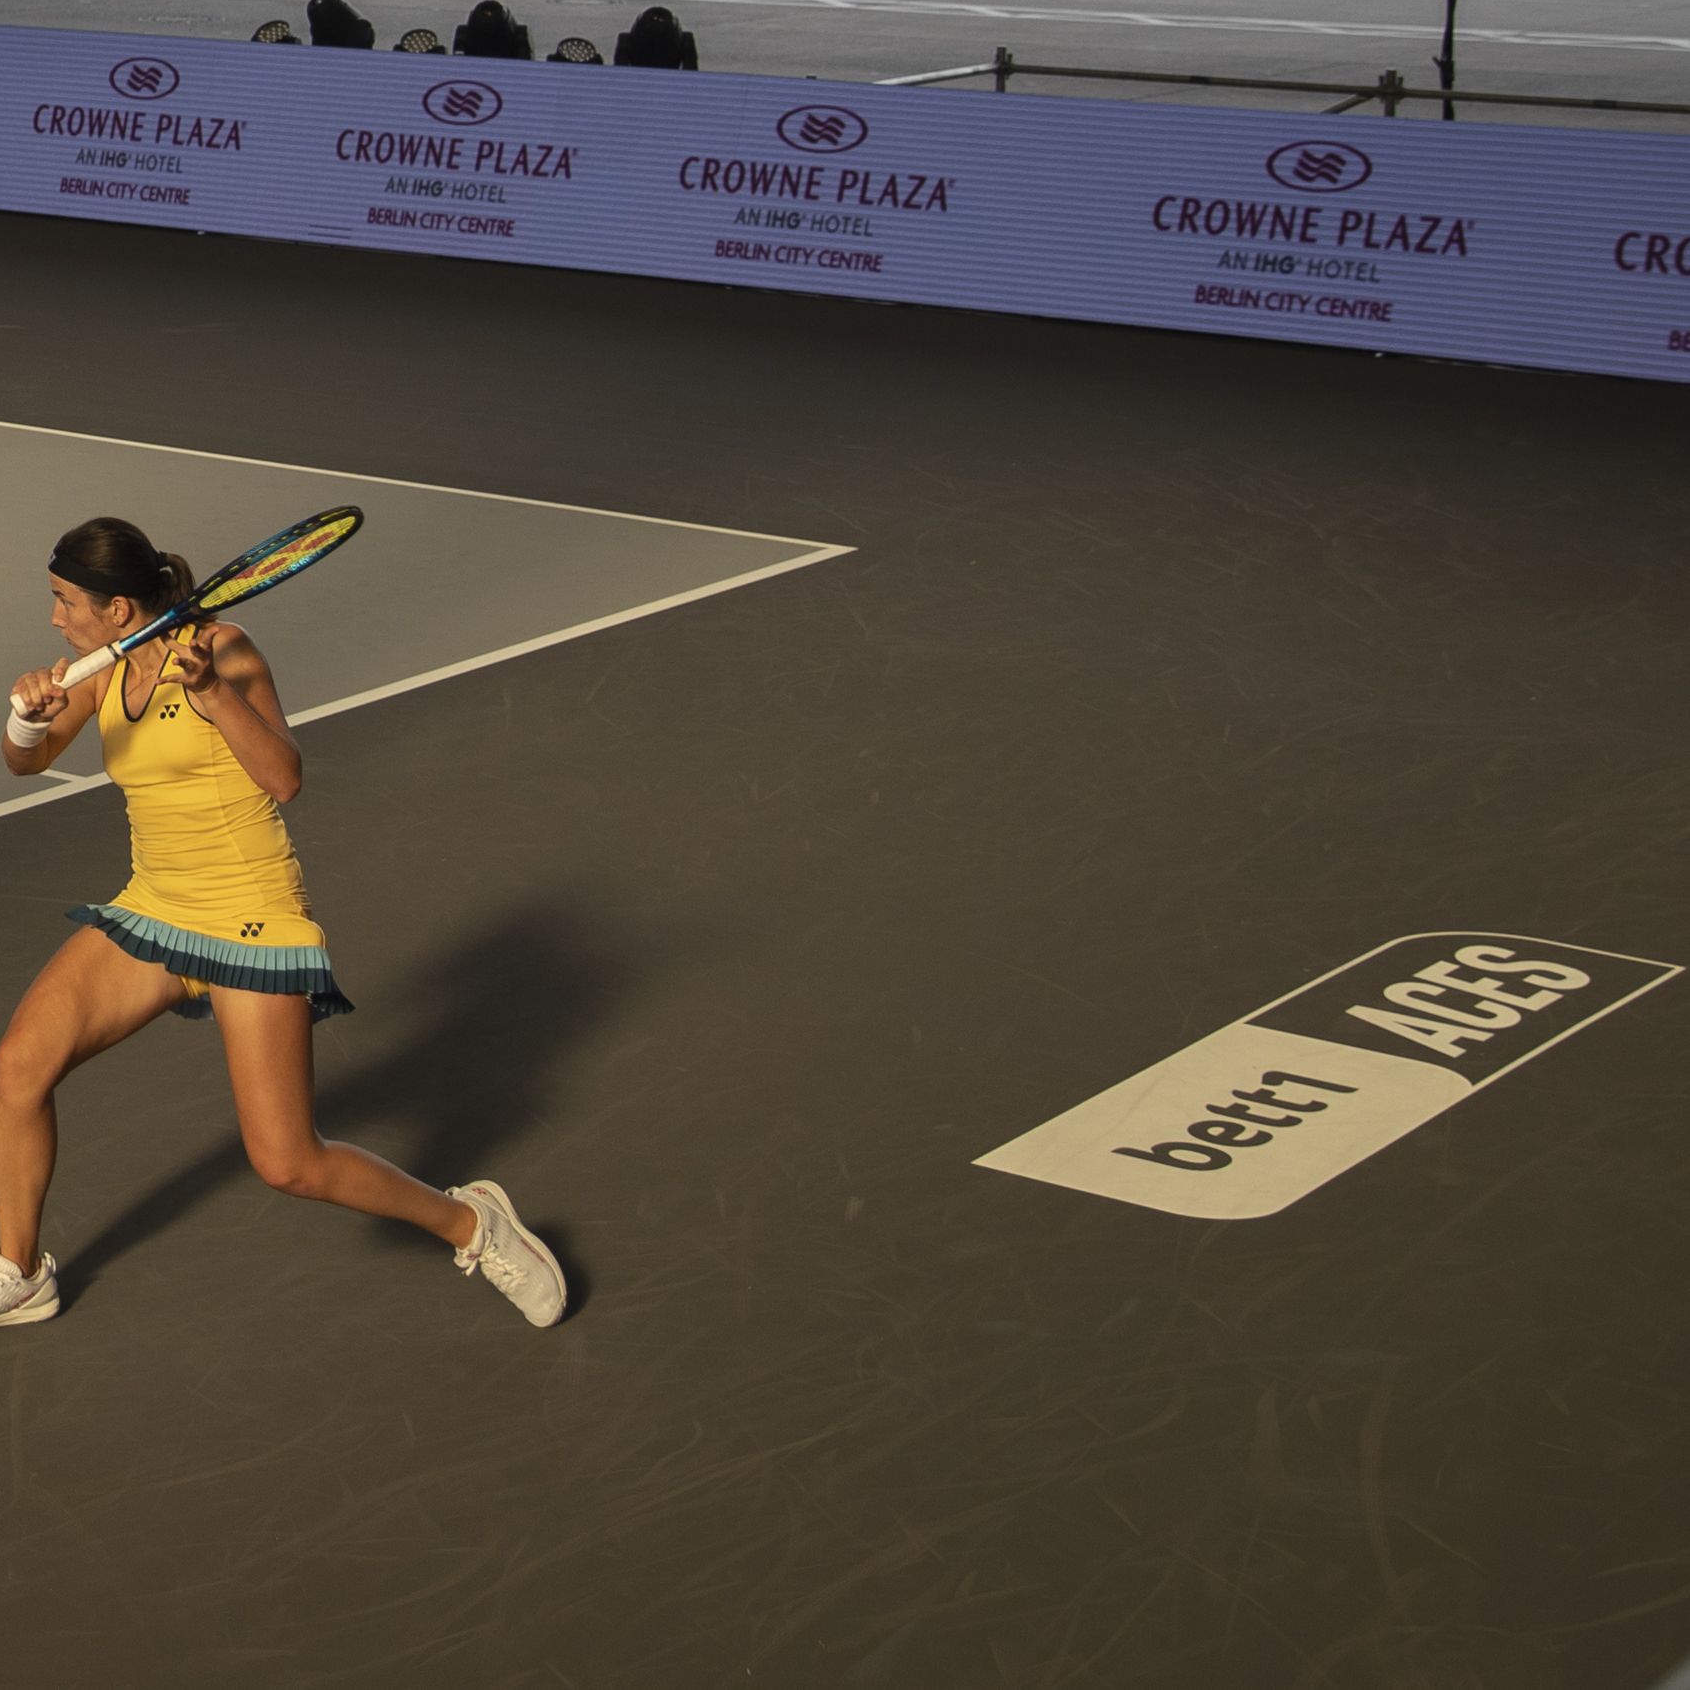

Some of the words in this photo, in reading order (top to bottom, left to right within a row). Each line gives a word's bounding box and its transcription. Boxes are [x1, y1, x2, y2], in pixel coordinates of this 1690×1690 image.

[32, 103, 147, 142] CROWNE
[155, 113, 241, 151] PLAZA
[75, 148, 97, 166] AN
[99, 151, 129, 169] IHG
[133, 154, 184, 175] HOTEL
[336, 128, 465, 171] CROWNE
[474, 139, 572, 180] PLAZA
[59, 177, 104, 197] BERLIN
[106, 181, 138, 200] CITY
[139, 184, 192, 206] CENTRE
[383, 176, 408, 196] AN
[411, 178, 444, 198] IHG
[450, 183, 508, 205] HOTEL
[679, 156, 826, 202] CROWNE
[836, 168, 949, 213] PLAZA
[367, 206, 417, 228] BERLIN
[418, 211, 456, 233] CITY
[457, 215, 516, 238] CENTRE
[733, 207, 762, 227] AN
[764, 209, 802, 230] IHG
[808, 213, 874, 238] HOTEL
[1152, 194, 1323, 244] CROWNE
[1336, 209, 1469, 258] PLAZA
[714, 239, 771, 262] BERLIN
[773, 244, 816, 267] CITY
[817, 249, 884, 274] CENTRE
[1216, 248, 1249, 270] AN
[1253, 252, 1297, 275] IHG
[1305, 258, 1382, 284] HOTEL
[1194, 283, 1261, 309] BERLIN
[1264, 291, 1311, 315] CITY
[1314, 297, 1394, 323] CENTRE
[1110, 1070, 1360, 1172] bett1
[1343, 944, 1592, 1059] ACES
